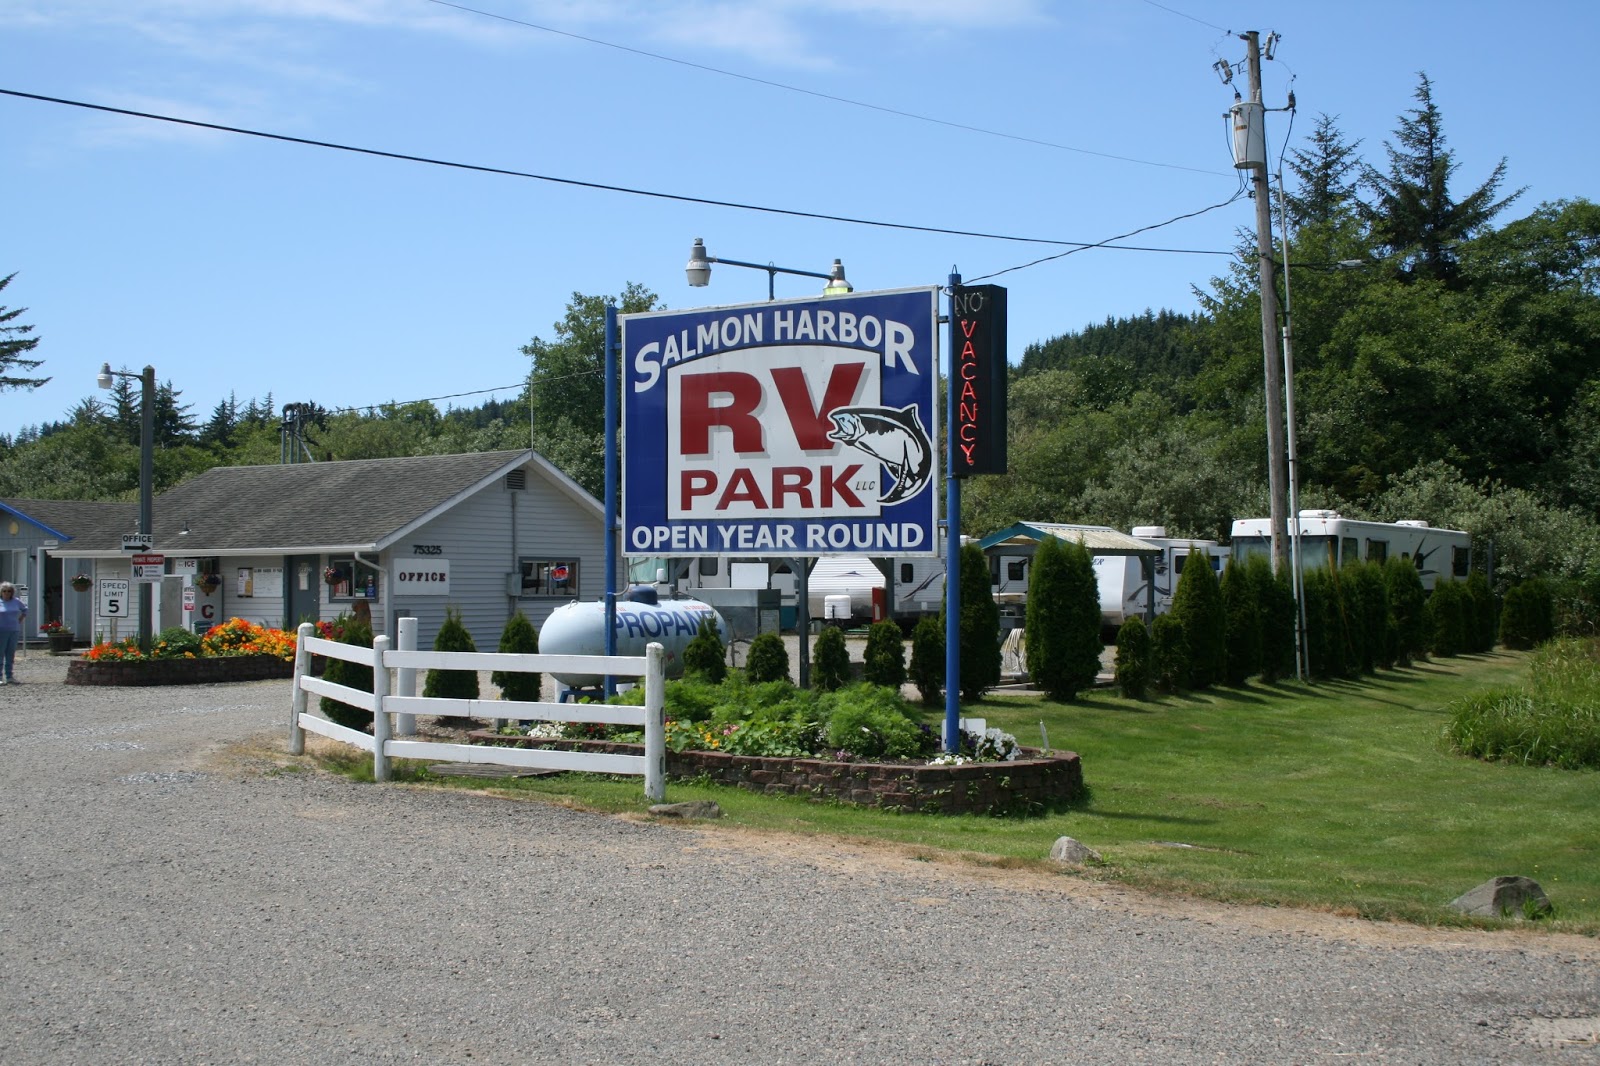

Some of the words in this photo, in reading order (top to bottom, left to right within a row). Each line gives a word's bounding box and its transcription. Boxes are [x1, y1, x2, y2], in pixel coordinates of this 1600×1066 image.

[954, 292, 983, 317] NO
[634, 312, 763, 393] SALMON
[774, 310, 919, 375] HARBOR
[960, 319, 976, 466] VACANCY
[680, 362, 866, 455] RV
[680, 464, 866, 511] PARK
[855, 480, 876, 491] LLC
[122, 535, 152, 543] OFFICE
[632, 525, 708, 549] OPEN
[717, 524, 796, 549] YEAR
[806, 523, 924, 548] ROUND
[413, 545, 442, 555] 75325
[133, 566, 143, 577] NO
[399, 572, 446, 582] OFFICE
[102, 582, 127, 590] SPEED
[108, 600, 119, 613] 5
